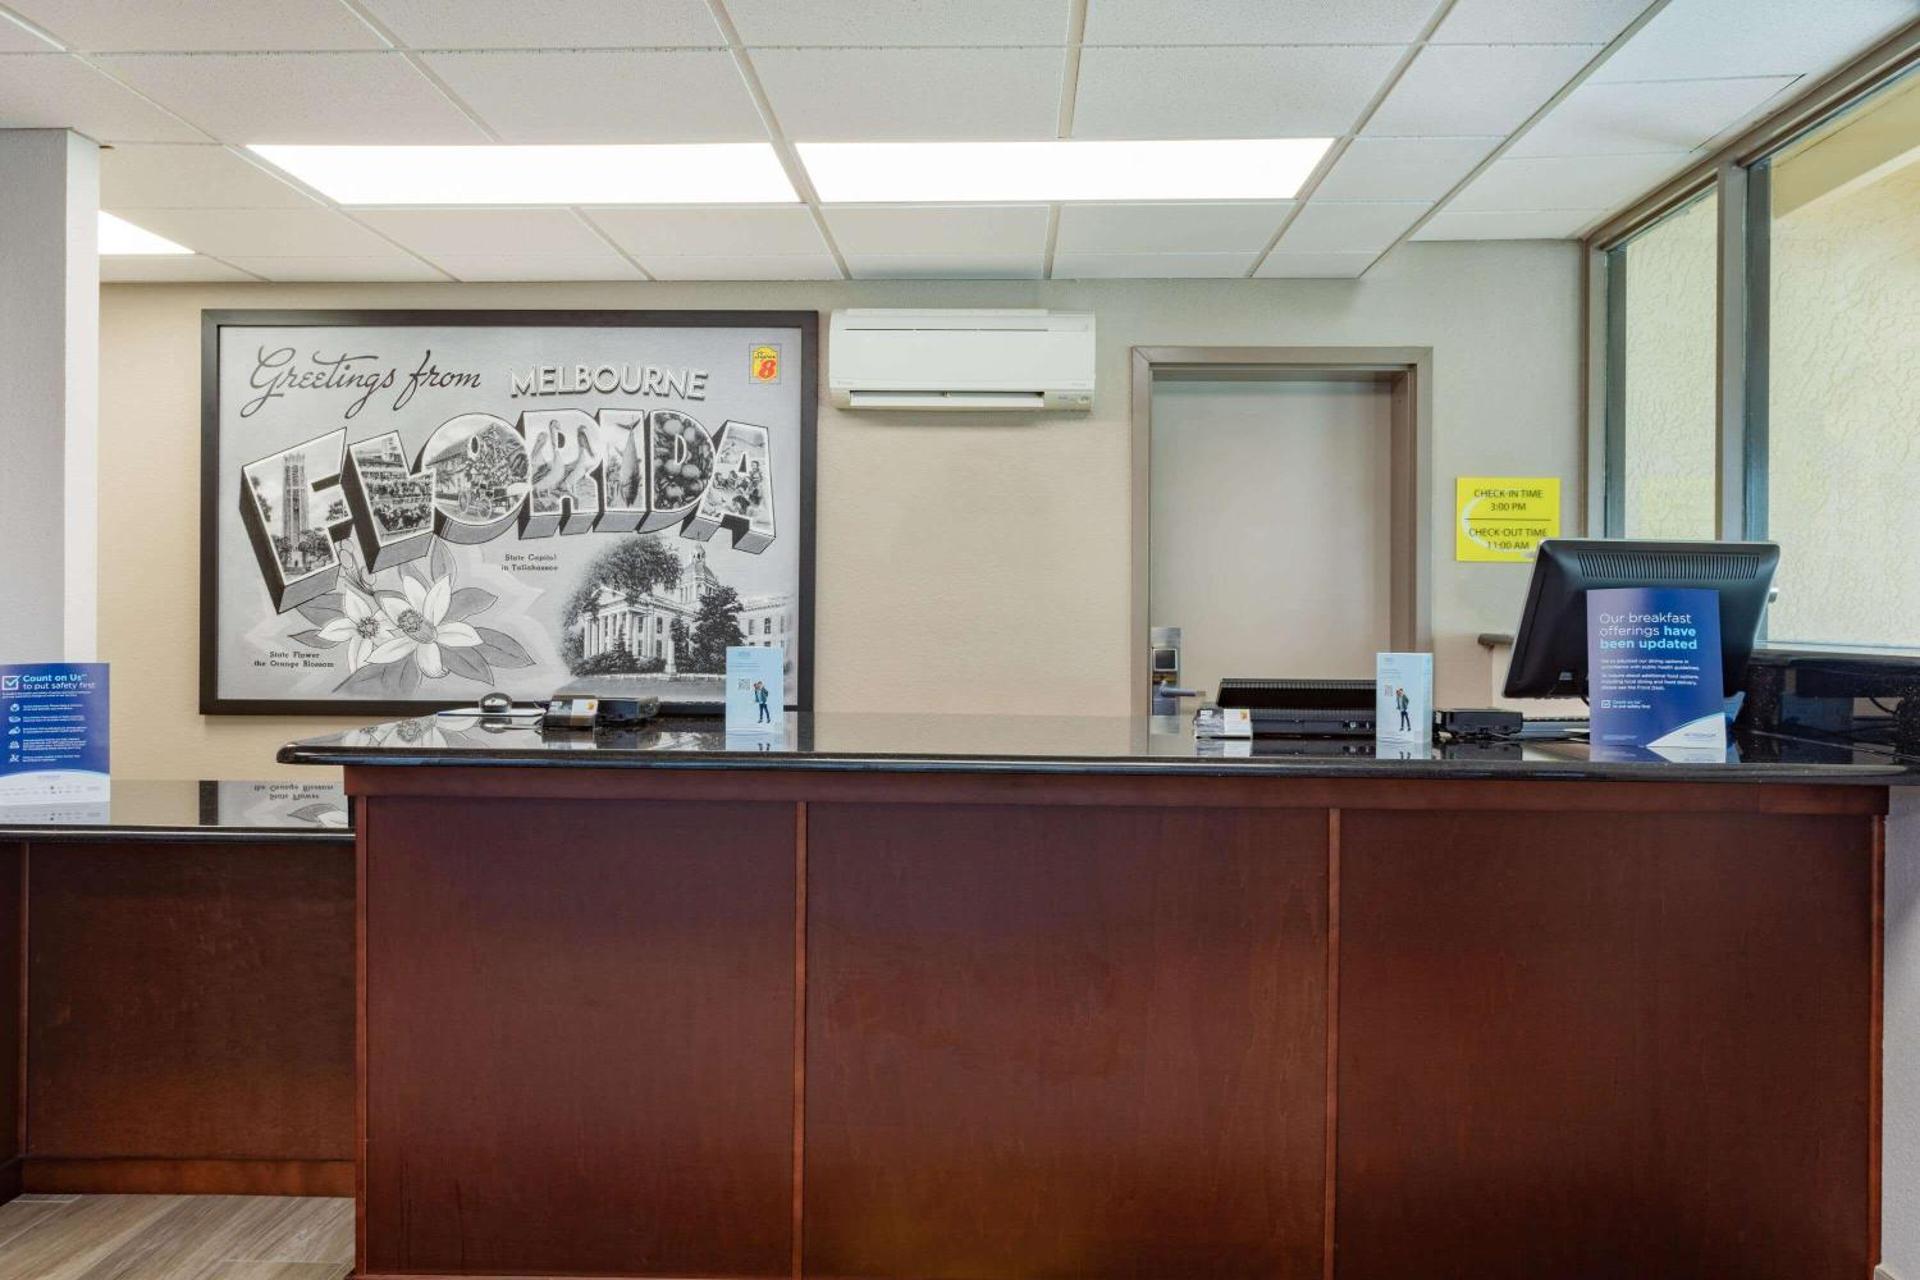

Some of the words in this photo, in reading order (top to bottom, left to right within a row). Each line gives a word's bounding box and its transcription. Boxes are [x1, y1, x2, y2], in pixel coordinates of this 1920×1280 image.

[758, 359, 777, 379] 8
[240, 346, 397, 419] Greetings
[393, 349, 481, 411] from
[510, 362, 709, 401] MELBOURNE
[1521, 489, 1545, 498] TIME
[240, 408, 777, 614] FLORIDA
[1490, 502, 1510, 511] 3:00
[1511, 502, 1527, 511] PM
[1525, 528, 1547, 537] TIME
[1487, 541, 1512, 549] 11:00
[1513, 541, 1530, 550] AM
[1600, 613, 1625, 624] Our
[1628, 611, 1692, 624] breakfast
[1600, 625, 1660, 638] offerings
[1663, 625, 1696, 637] have
[1600, 639, 1634, 650] been
[1639, 638, 1698, 651] updated
[22, 674, 53, 683] Count
[54, 675, 67, 683] on
[34, 683, 49, 692] put
[51, 682, 78, 692] safety
